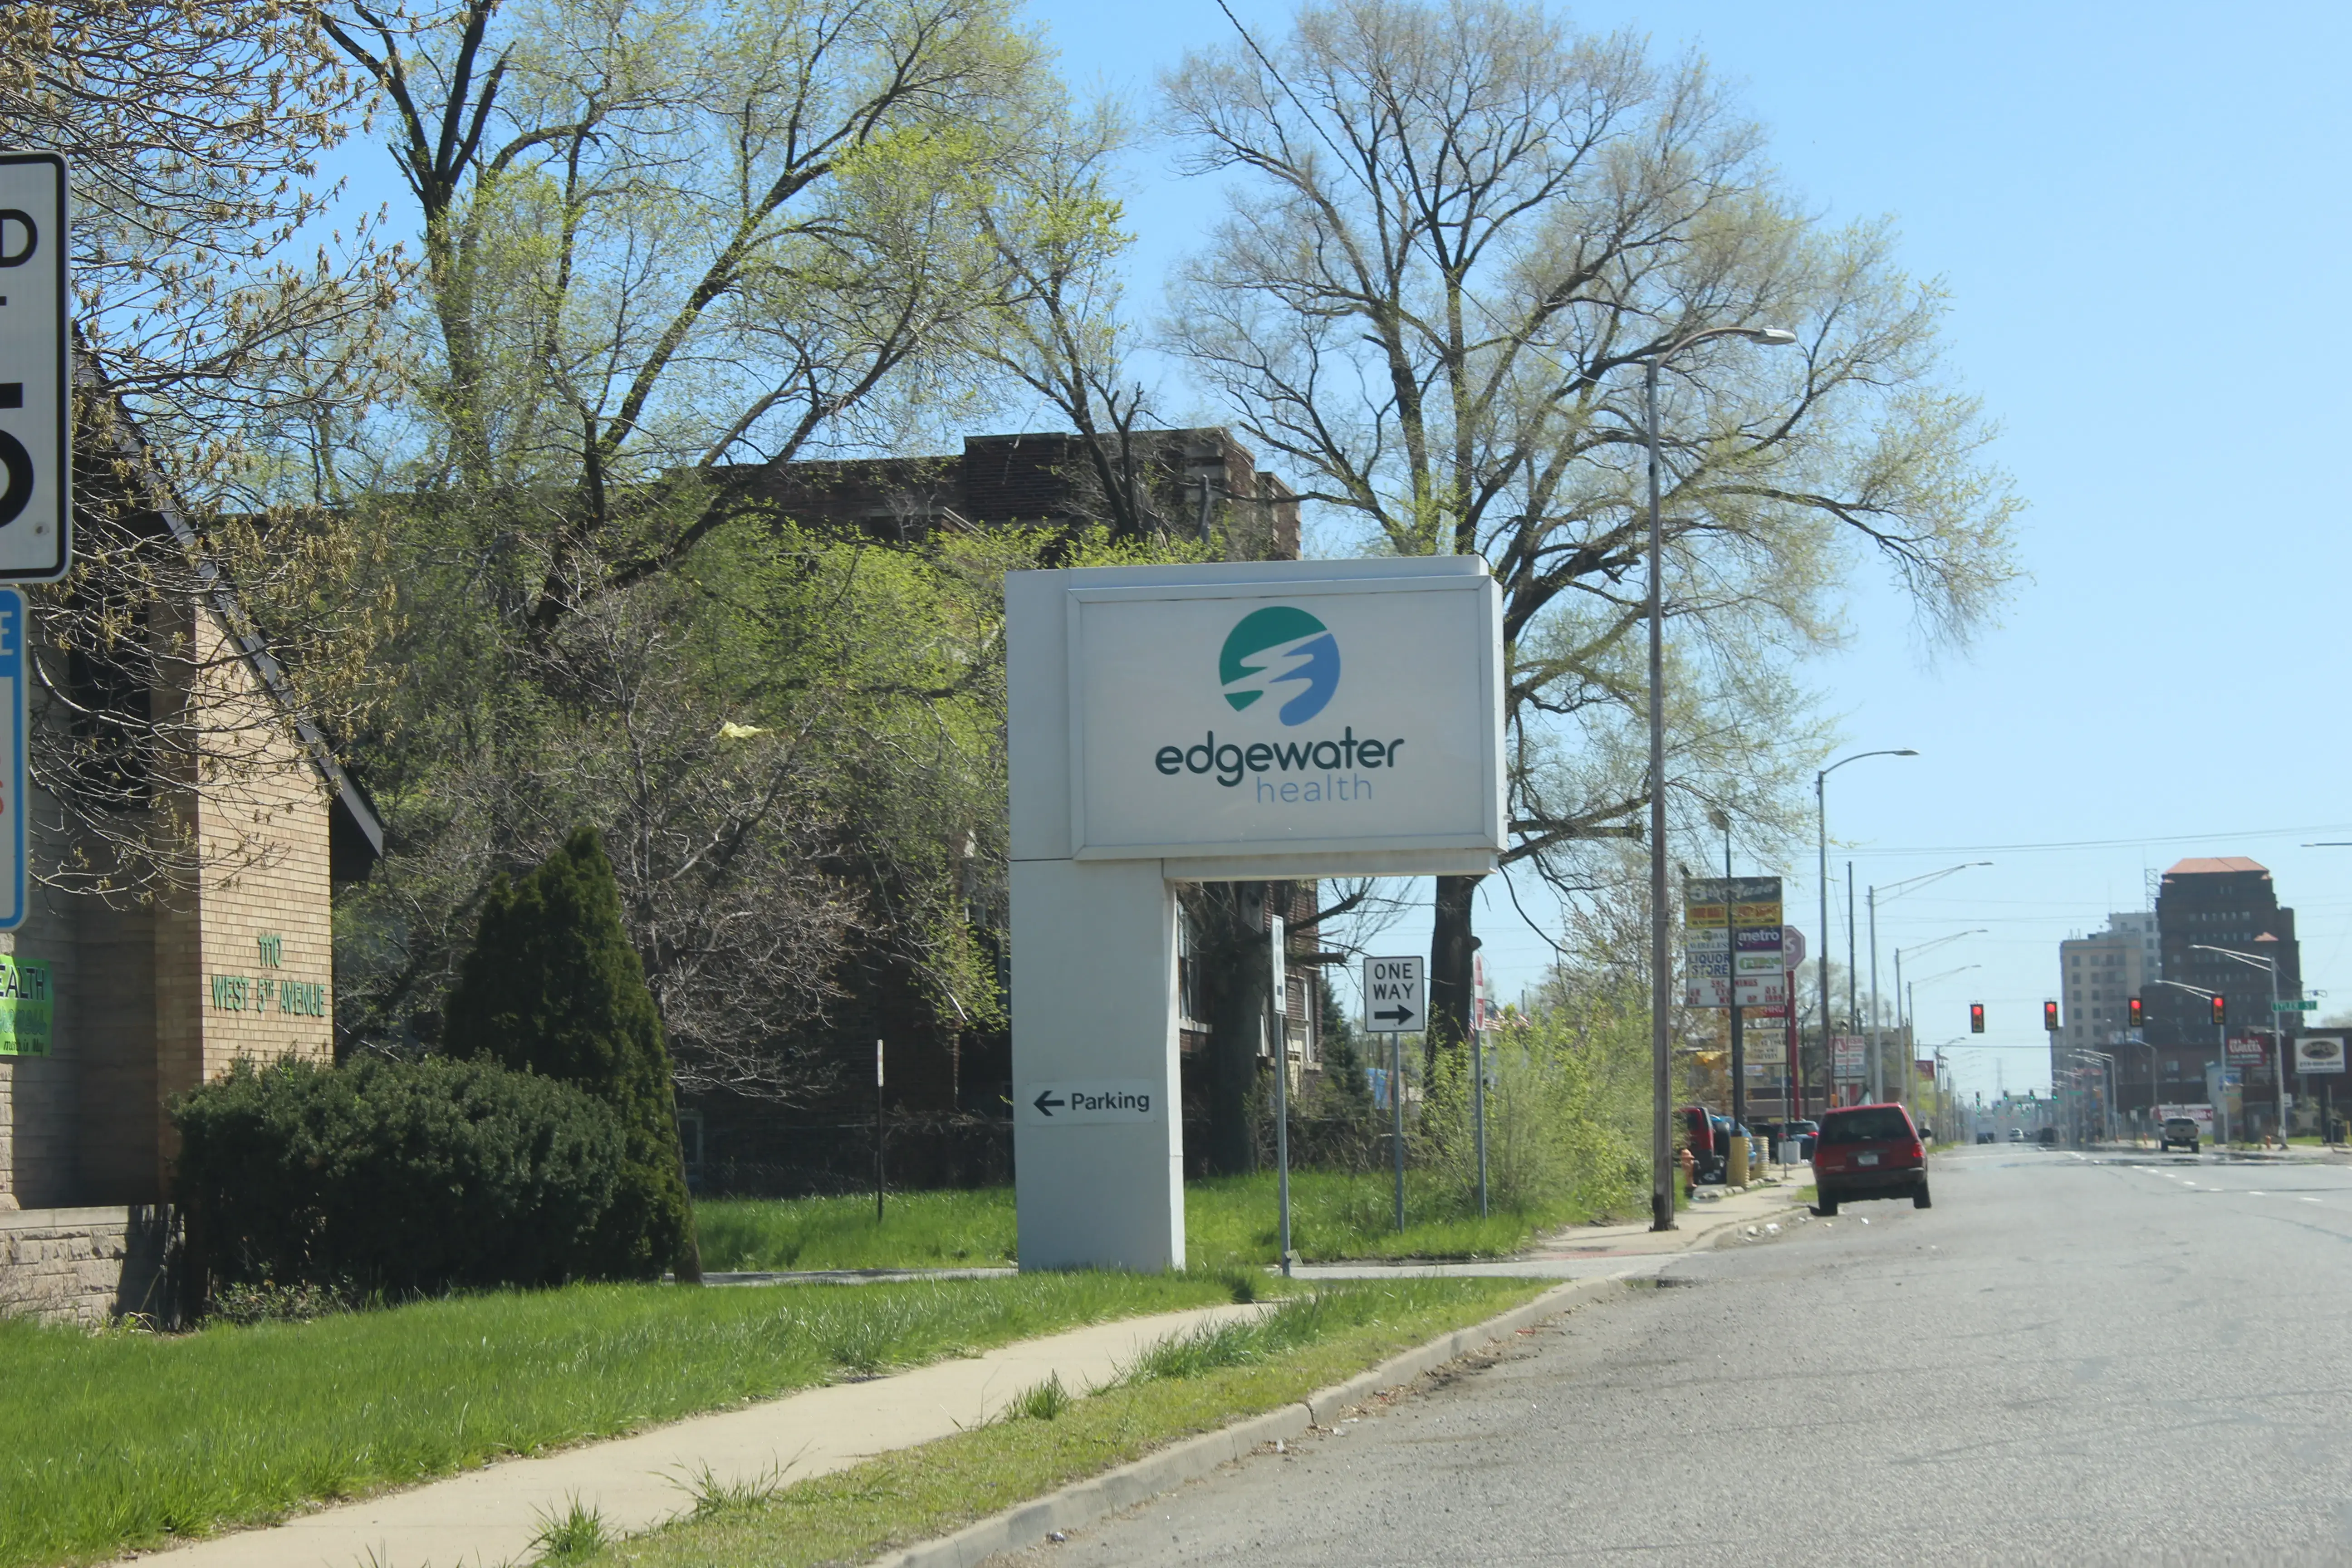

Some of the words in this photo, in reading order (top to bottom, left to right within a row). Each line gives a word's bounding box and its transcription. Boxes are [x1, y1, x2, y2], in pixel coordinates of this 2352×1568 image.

[1155, 726, 1405, 787] edgewater
[1256, 773, 1372, 803] health
[258, 935, 282, 968] 1110
[1375, 963, 1413, 980] ONE
[1691, 964, 1728, 975] STORE
[212, 975, 249, 1011] WEST
[279, 980, 326, 1017] AVENUE
[1373, 983, 1414, 1000] WAY
[1071, 1091, 1150, 1112] Parking
